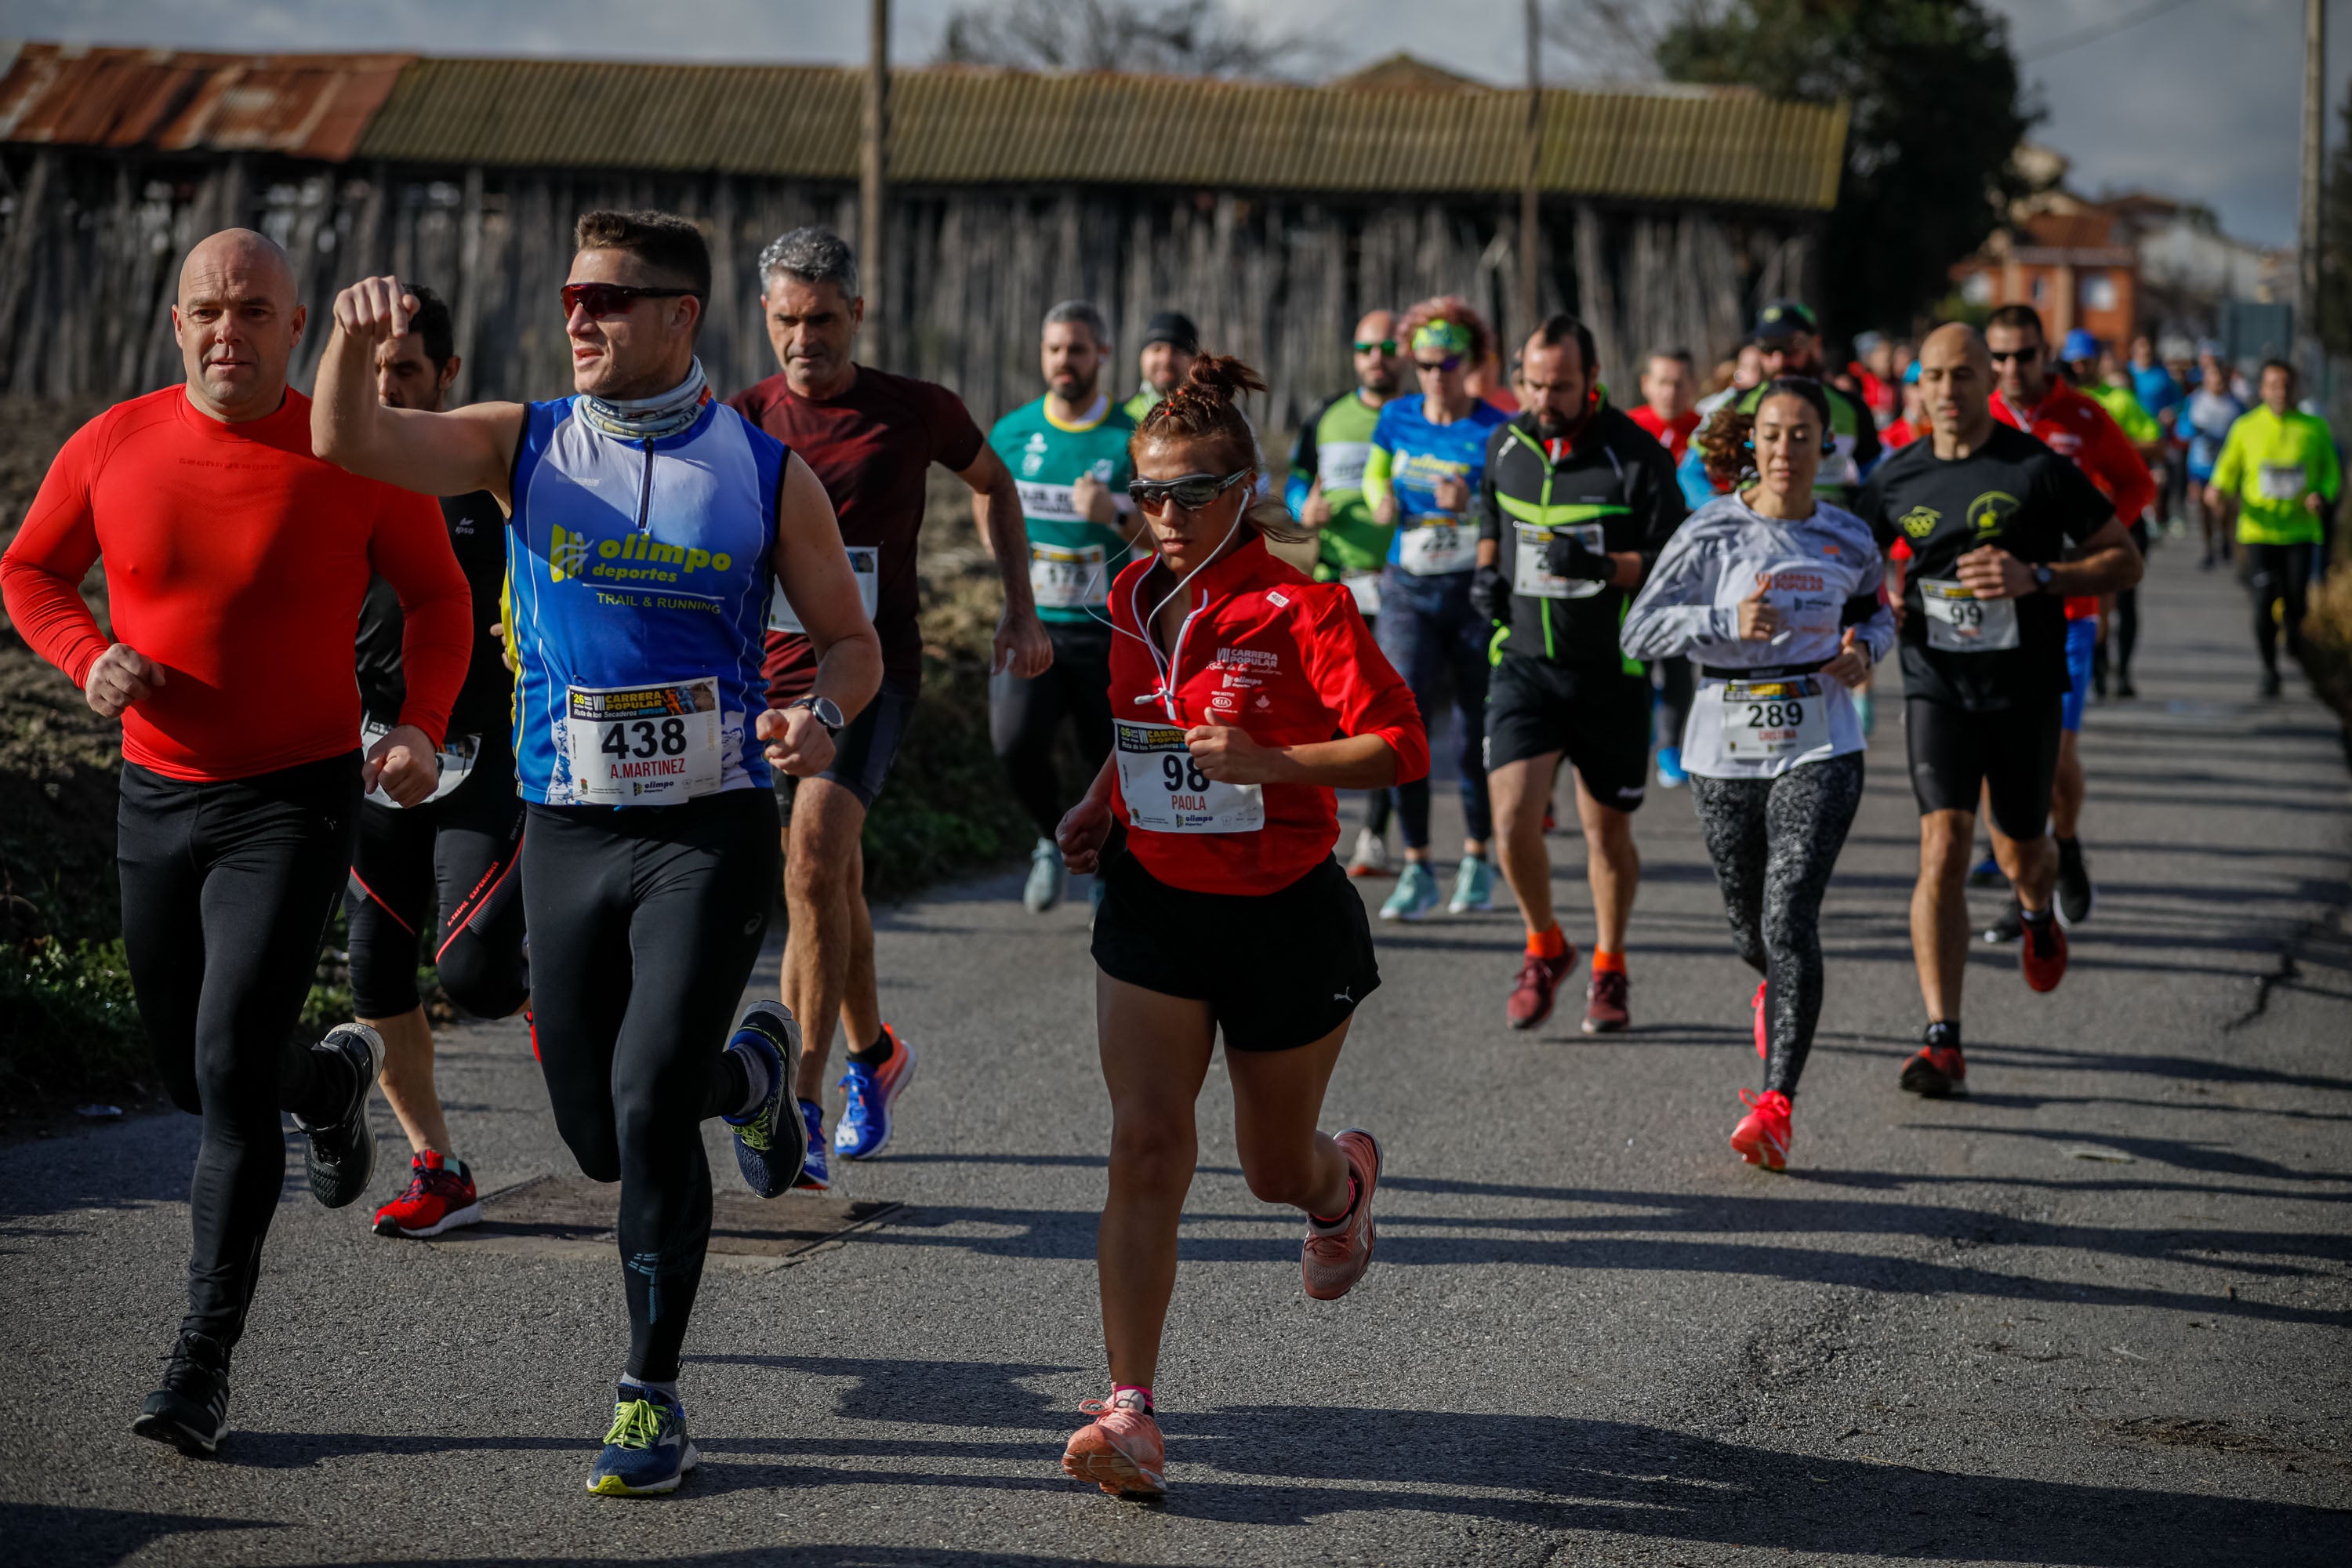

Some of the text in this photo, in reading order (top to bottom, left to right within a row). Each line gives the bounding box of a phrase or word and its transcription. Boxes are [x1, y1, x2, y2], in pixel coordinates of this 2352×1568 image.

[598, 532, 732, 574] olimpo
[592, 563, 677, 583] deportes
[597, 592, 720, 614] TRAIL & RUNNING
[1229, 656, 1278, 667] POPULAR
[1231, 649, 1278, 661] CARRERA
[1233, 676, 1263, 685] olimpo
[573, 693, 585, 705] 26
[605, 691, 662, 704] CARRERA
[605, 699, 662, 710] POPULAR
[573, 708, 586, 717] Ruta
[1748, 702, 1803, 728] 289
[601, 717, 687, 760] 438
[610, 758, 685, 779] A.MARTINEZ
[1163, 754, 1210, 793] 98
[644, 780, 674, 789] olimpo
[1171, 795, 1207, 811] PAOLA
[1185, 815, 1213, 823] olimpo
